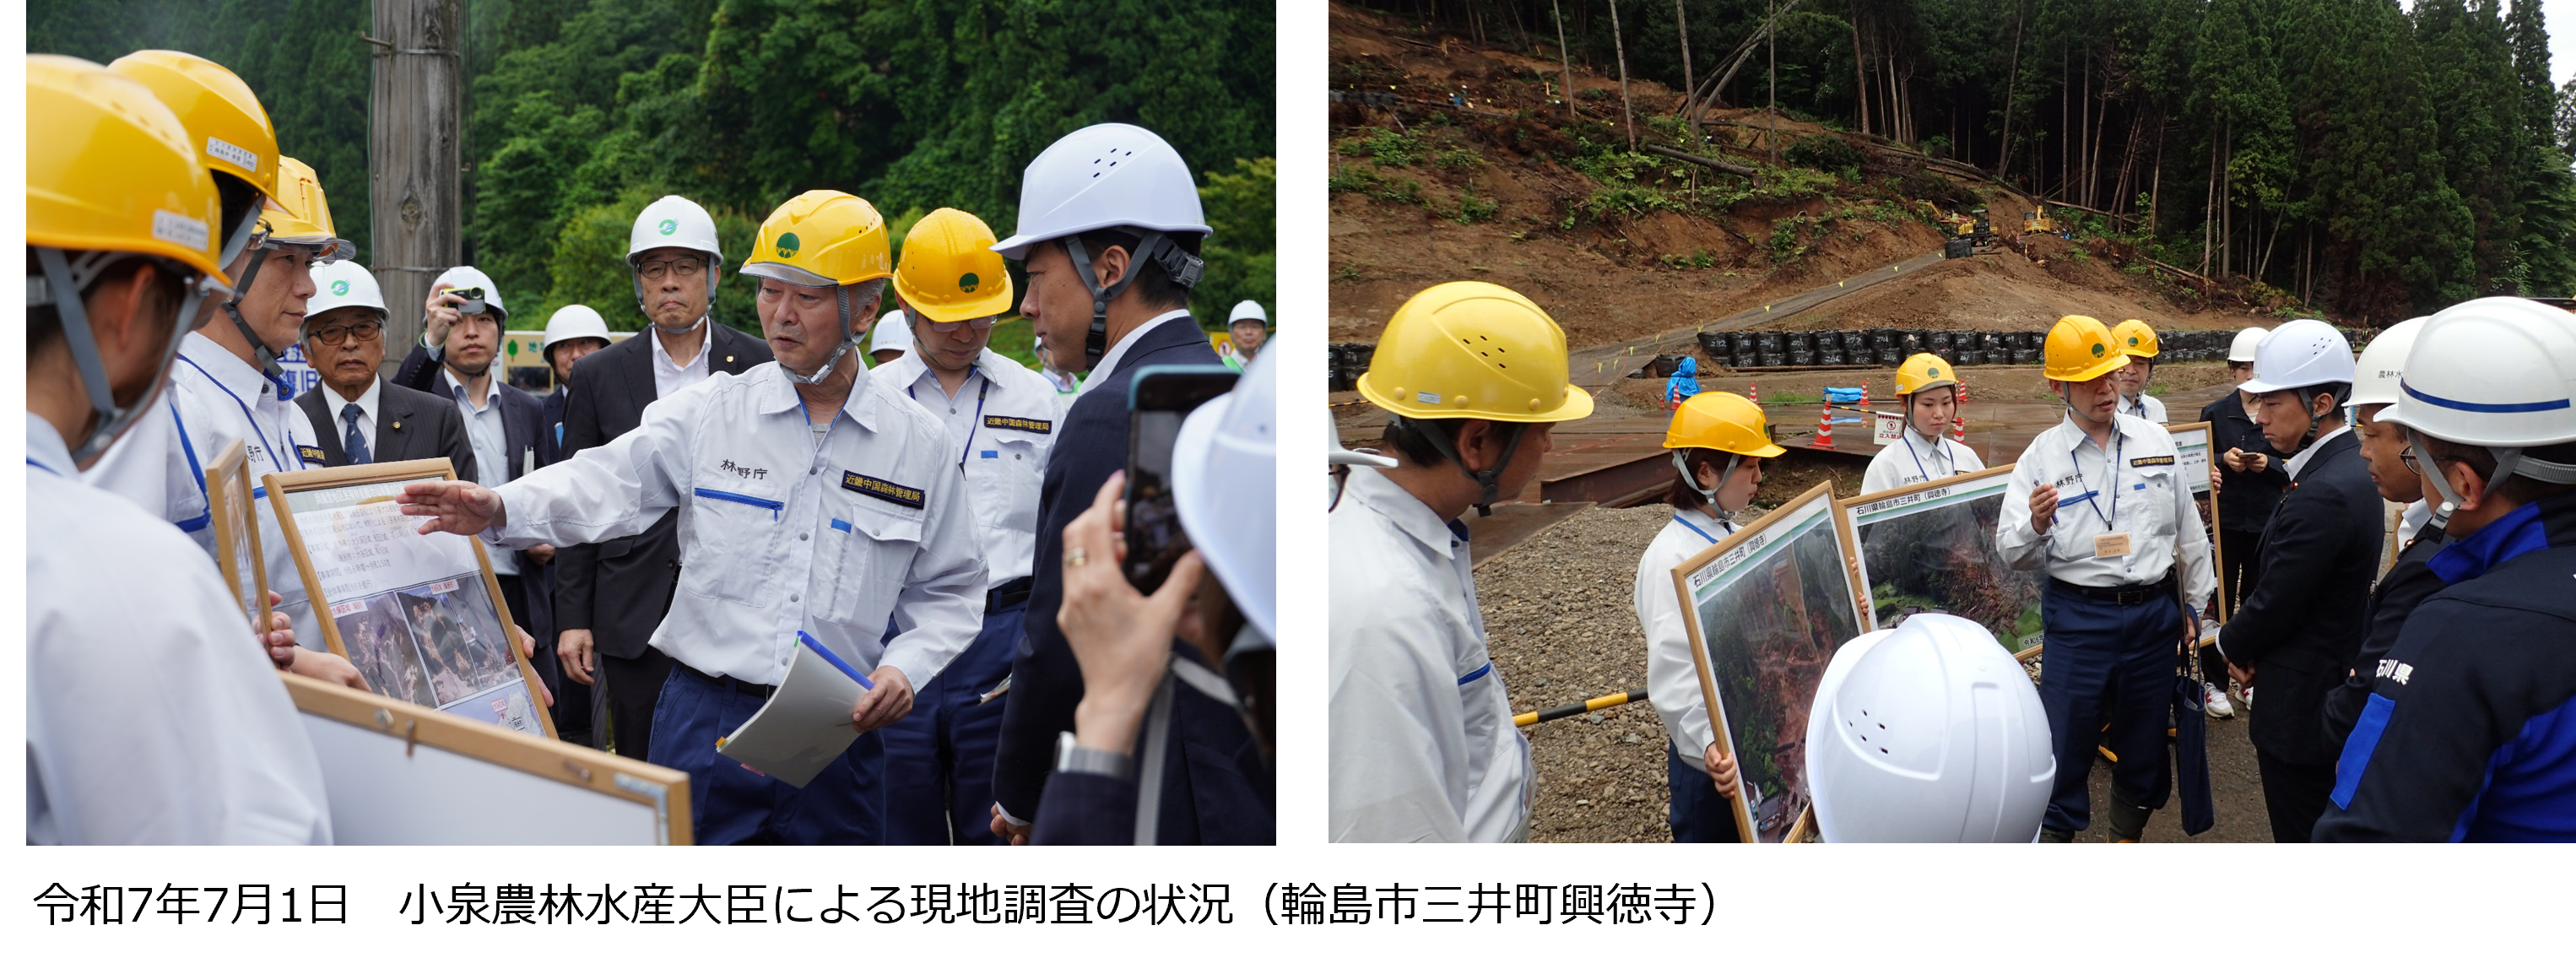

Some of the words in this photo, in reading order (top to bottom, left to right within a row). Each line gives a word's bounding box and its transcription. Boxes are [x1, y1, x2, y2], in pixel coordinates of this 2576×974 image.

[987, 417, 1050, 430] 近畿中国森林管理局
[720, 458, 768, 480] 林野庁
[845, 473, 920, 501] 近畿中国森林管理局
[2056, 473, 2083, 489] 林野庁
[2375, 658, 2414, 685] 石川県
